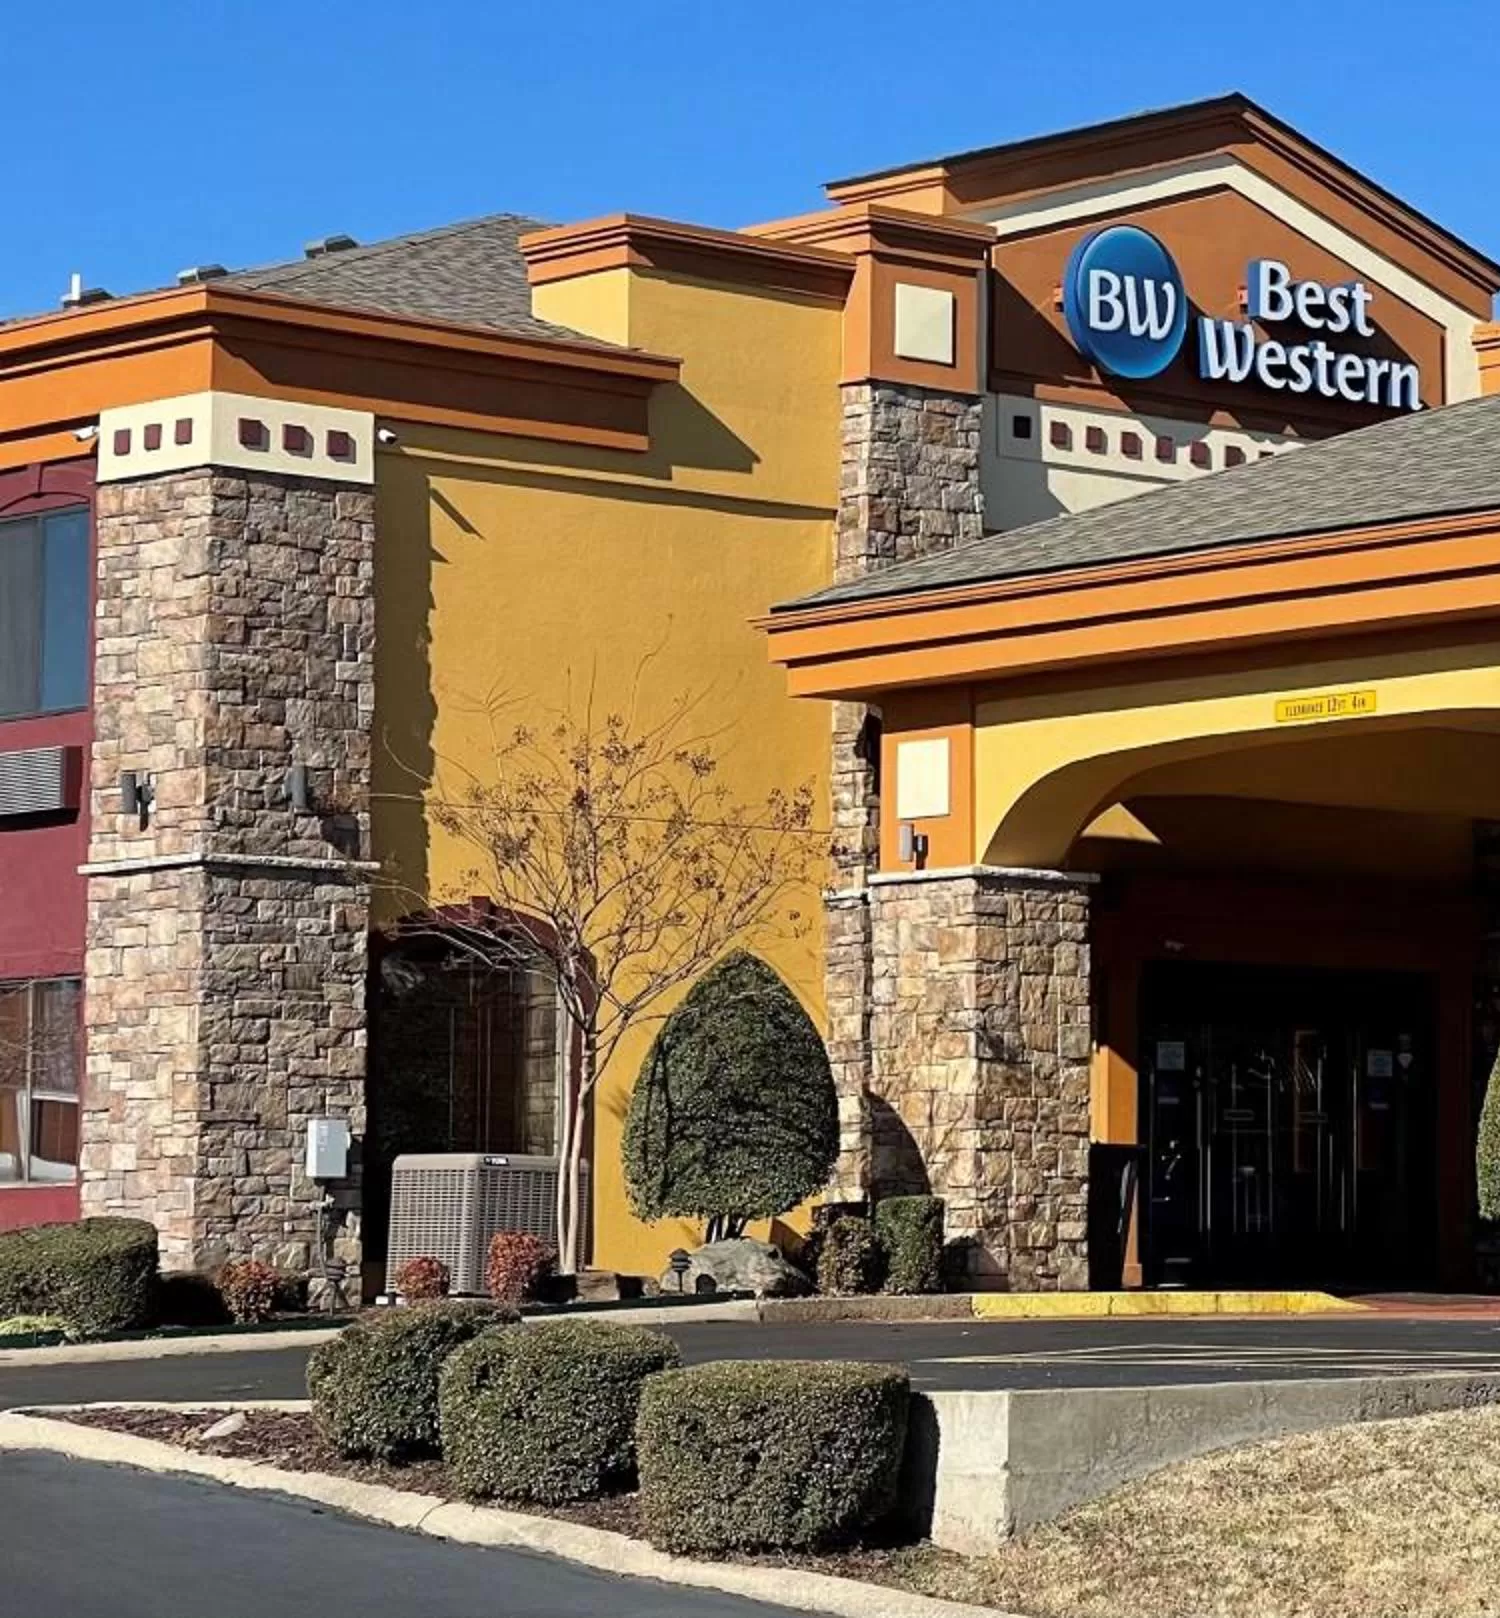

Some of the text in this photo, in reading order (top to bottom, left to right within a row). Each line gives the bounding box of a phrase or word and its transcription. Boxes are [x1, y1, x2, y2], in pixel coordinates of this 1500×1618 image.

[1088, 269, 1176, 341] BW
[1250, 258, 1376, 337] Best
[1200, 317, 1423, 411] Western
